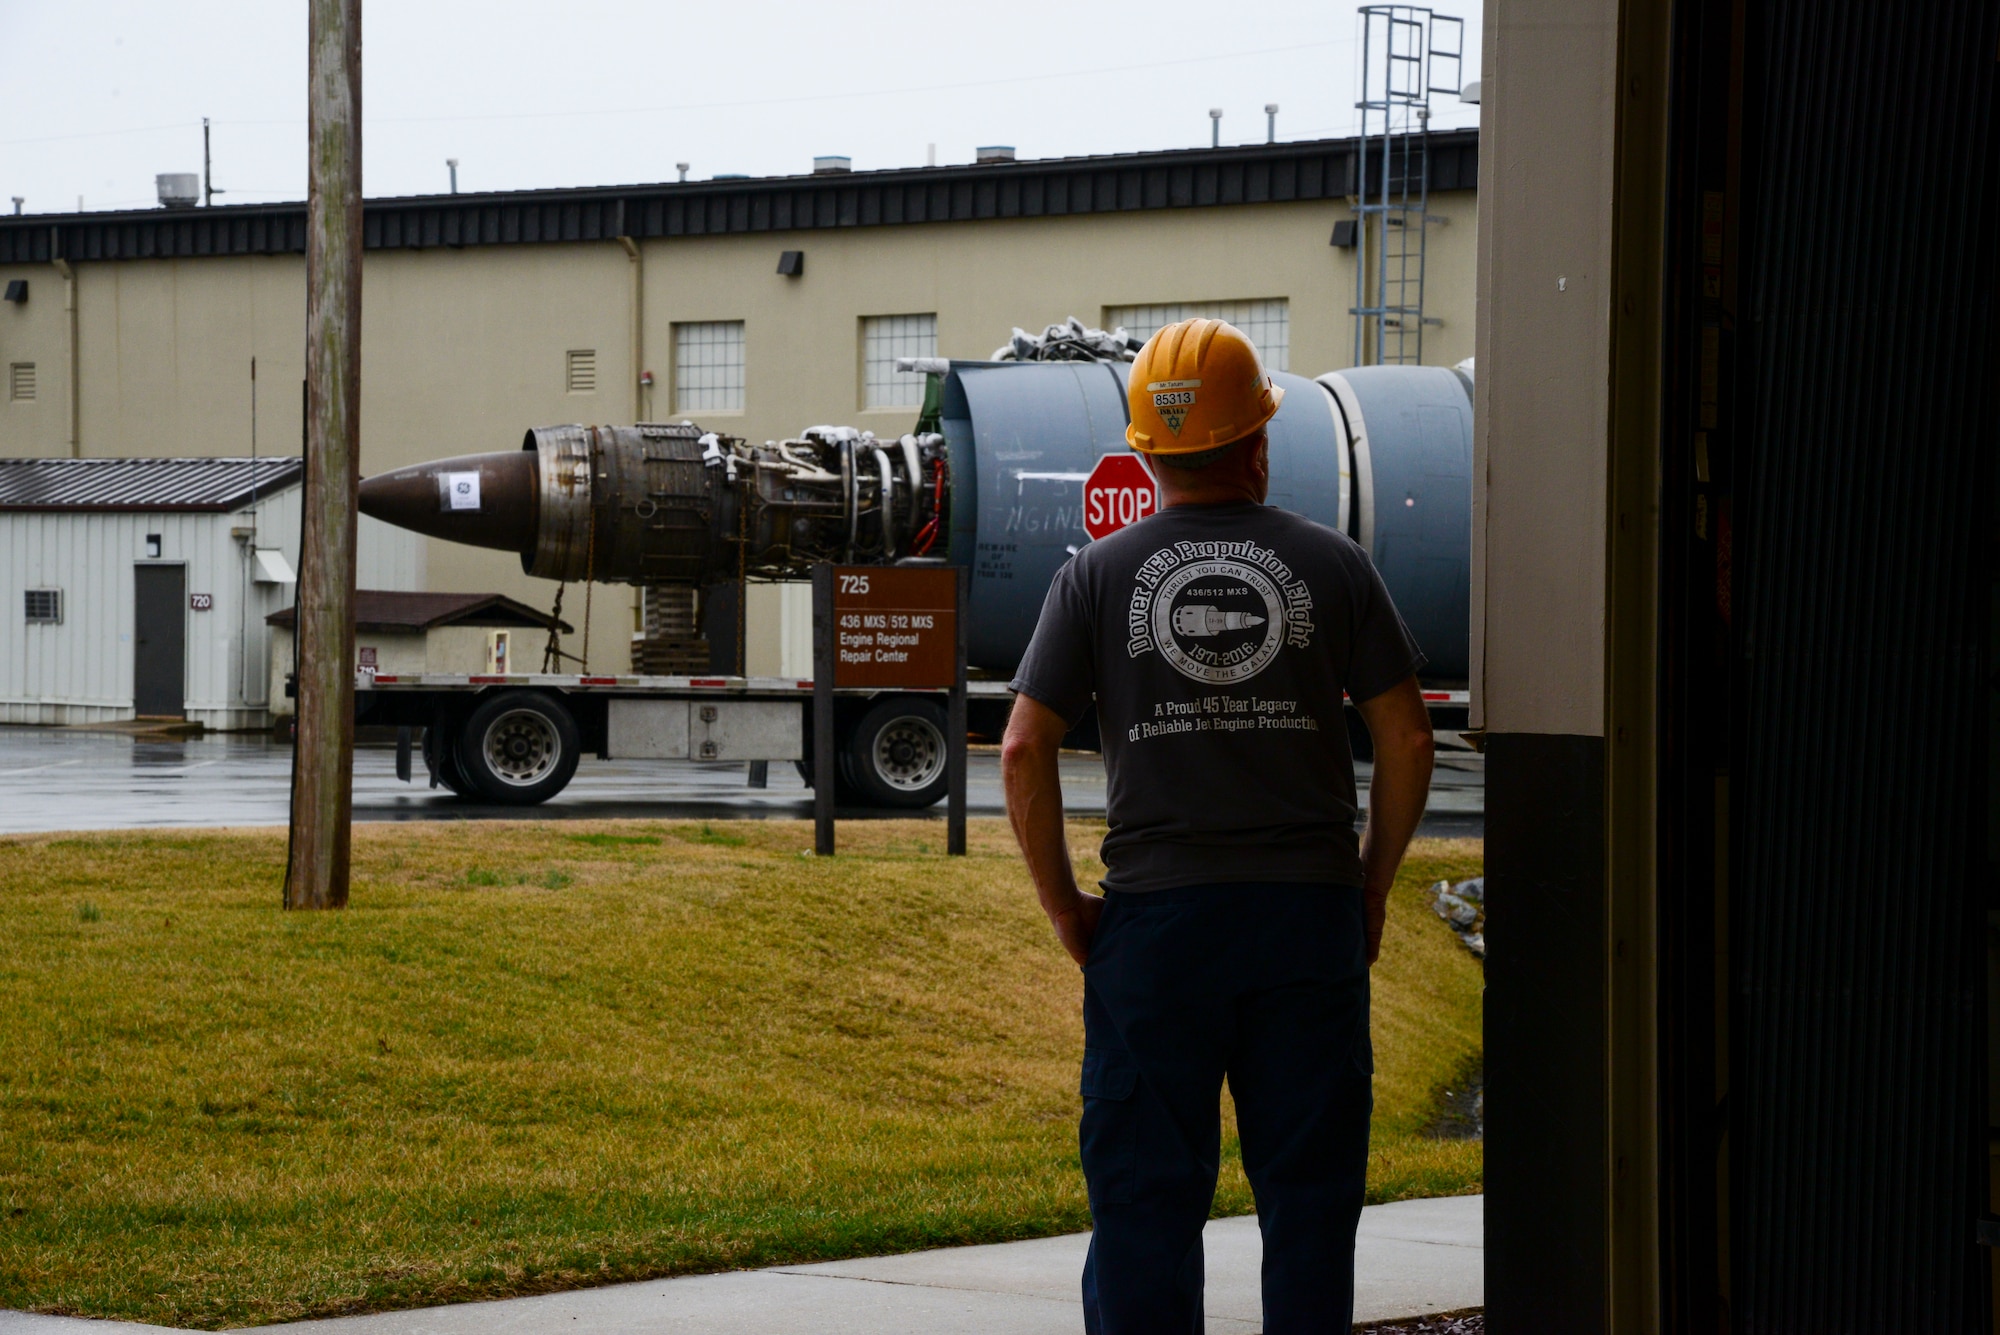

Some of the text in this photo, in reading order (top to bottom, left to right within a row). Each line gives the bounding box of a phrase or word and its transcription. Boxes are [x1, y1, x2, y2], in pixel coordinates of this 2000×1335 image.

[1155, 392, 1191, 406] 85313
[1159, 407, 1186, 415] ISRAEL
[1088, 487, 1152, 526] STOP
[978, 543, 1018, 552] BEWARE
[839, 575, 870, 594] 725
[1163, 566, 1272, 600] THRUST YOU CAN TRUST
[1127, 539, 1315, 659] Dover AFB Propulsion Flight
[1186, 587, 1249, 597] 436/512 MXS
[191, 595, 210, 608] 720
[839, 614, 861, 629] 436
[911, 615, 934, 629] MXS
[839, 632, 920, 648] Engine Regional
[839, 649, 909, 664] Repair Center
[1163, 635, 1277, 679] WE MOVE THE GALAXY
[1154, 695, 1297, 717] A Proud 45 Year Legacy
[1128, 715, 1319, 743] of Reliable Jet Engine Productio
